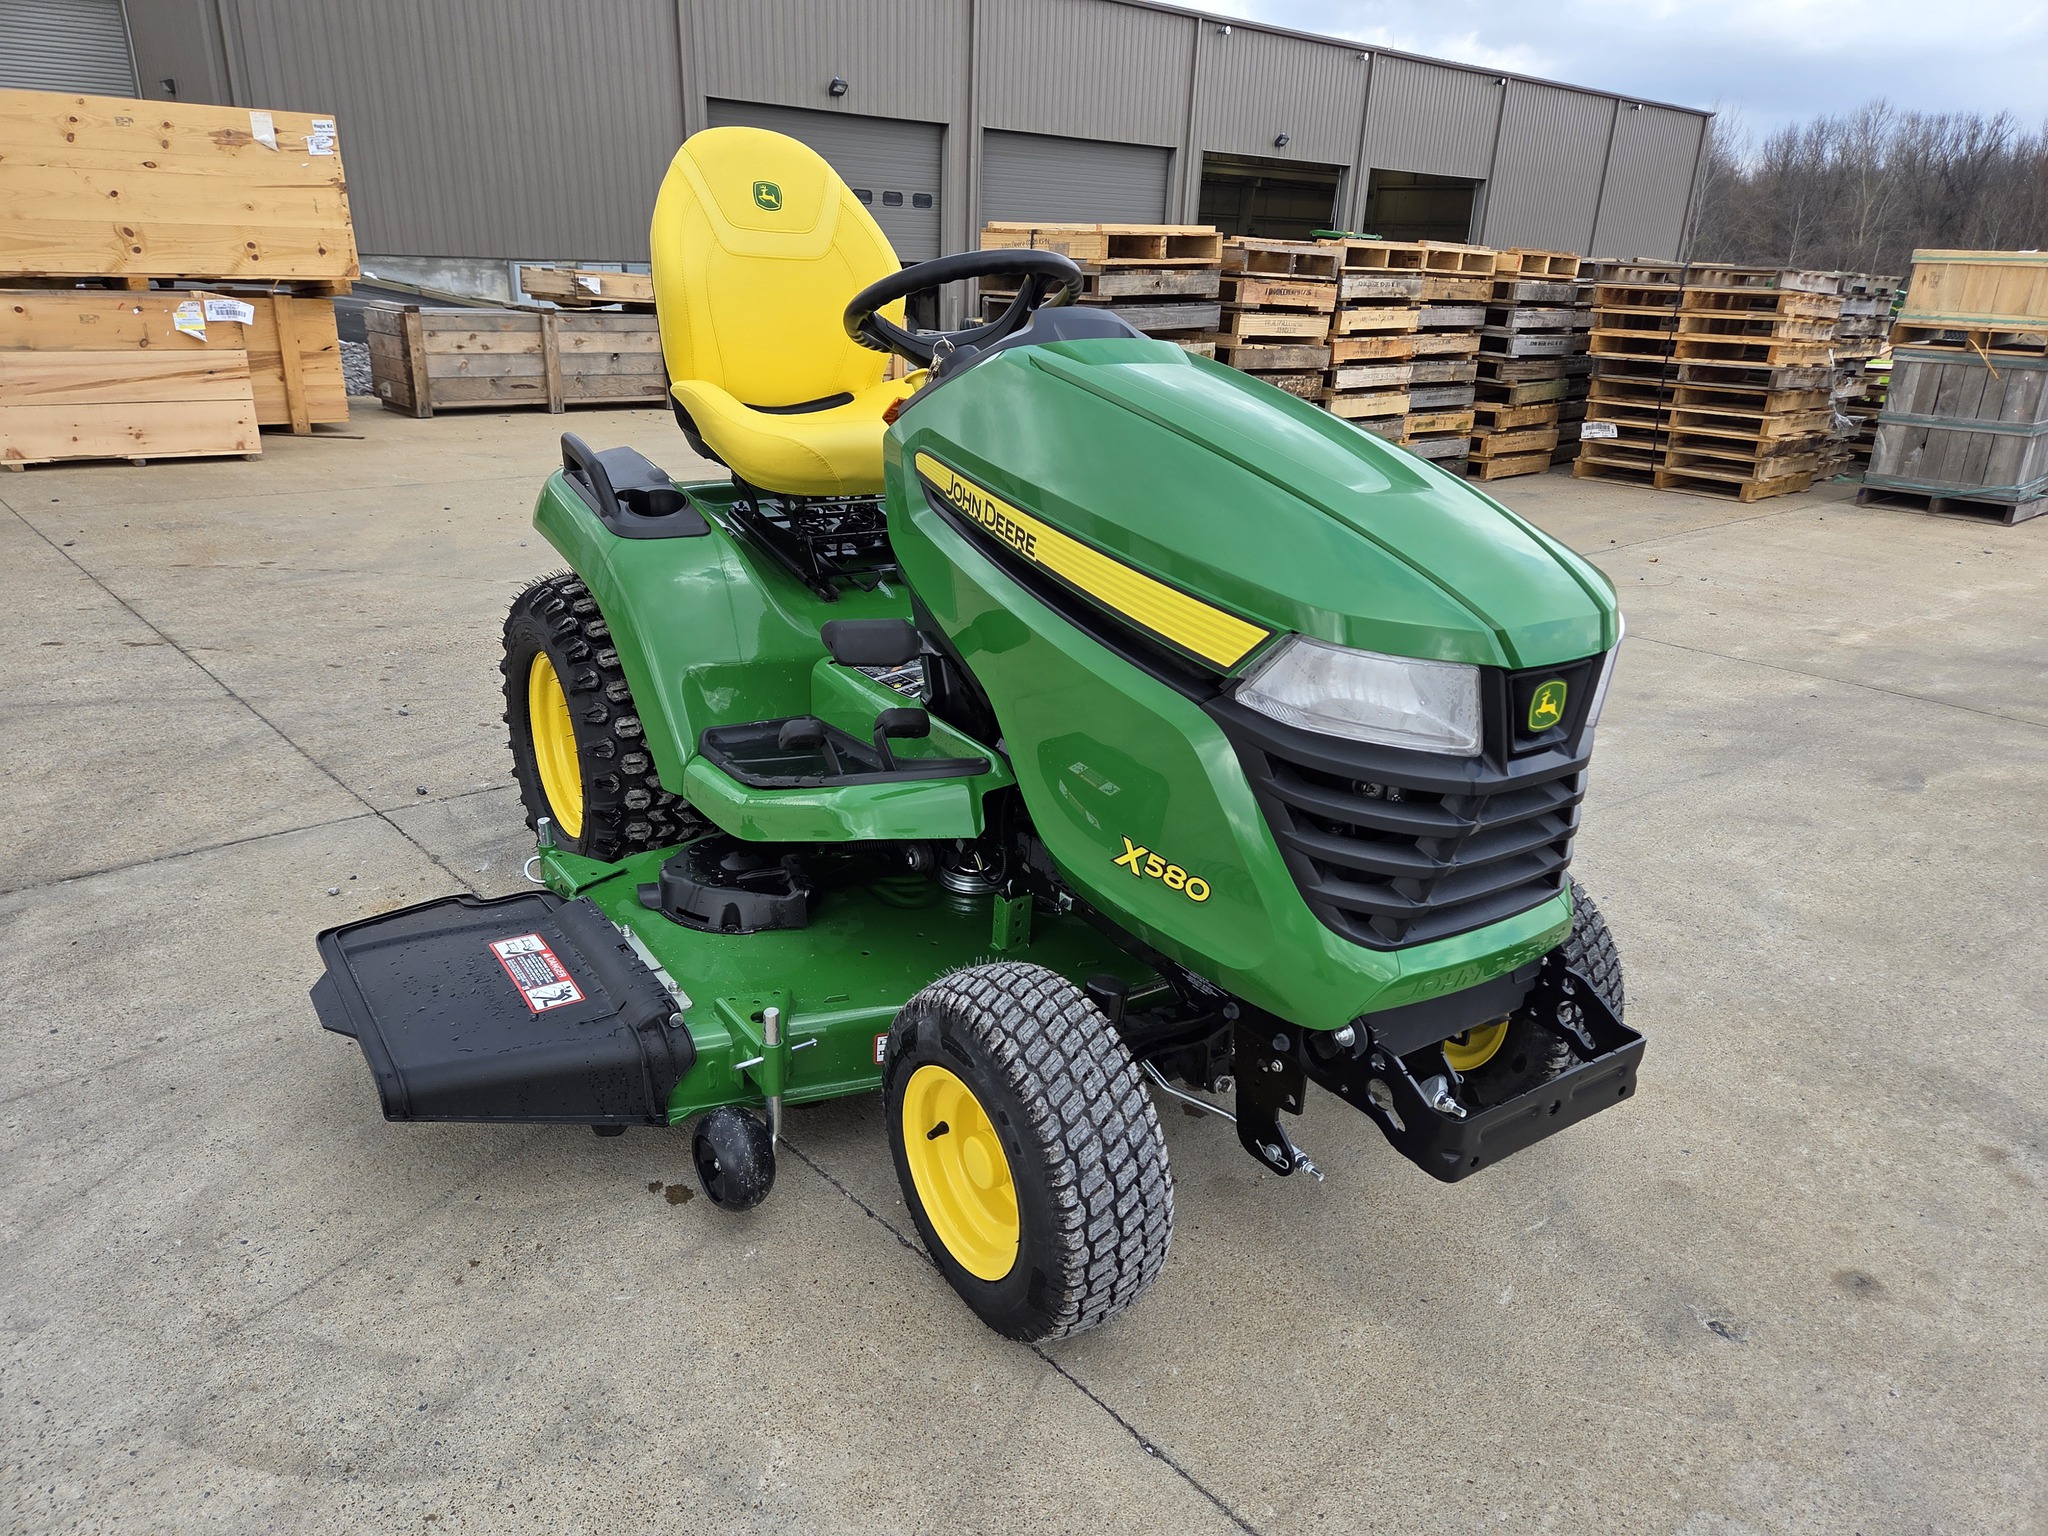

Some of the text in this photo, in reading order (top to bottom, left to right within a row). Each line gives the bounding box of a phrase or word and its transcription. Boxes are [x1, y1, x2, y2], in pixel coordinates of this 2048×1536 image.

[945, 473, 1037, 559] JOHN DEERE
[1110, 834, 1212, 903] X580
[546, 957, 567, 978] DANGER
[1398, 965, 1483, 1001] JOHN
